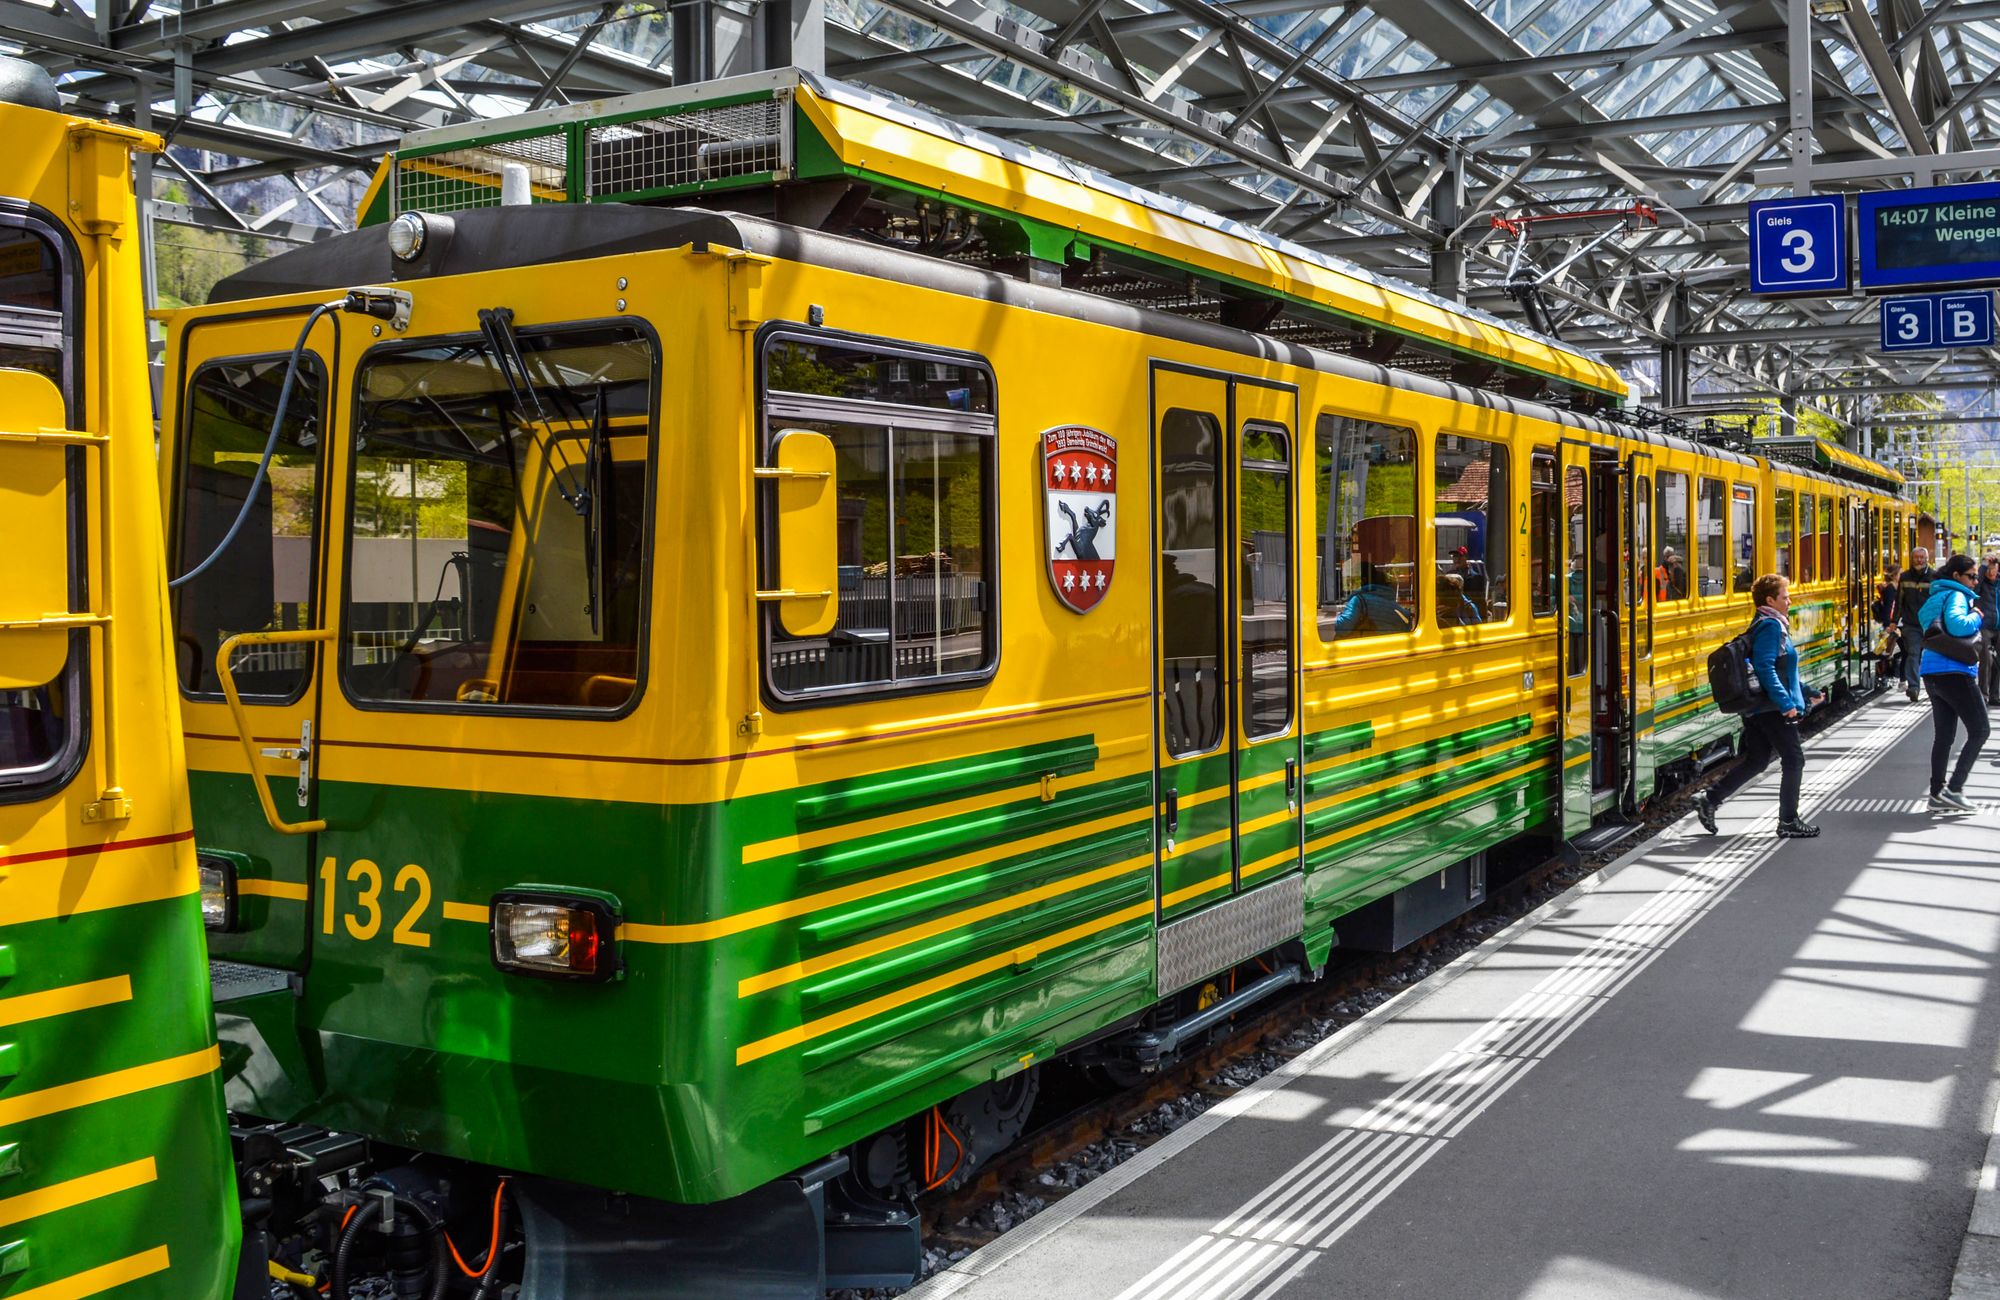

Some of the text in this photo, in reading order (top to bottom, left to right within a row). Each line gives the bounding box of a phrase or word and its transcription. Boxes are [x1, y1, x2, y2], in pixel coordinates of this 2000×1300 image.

[1767, 216, 1793, 227] Gleis
[1880, 204, 1996, 227] 14:07 Kleine
[1781, 229, 1815, 274] 3
[1898, 313, 1919, 340] 3
[1953, 310, 1976, 338] B
[1519, 501, 1527, 535] 2
[320, 856, 432, 948] 132
